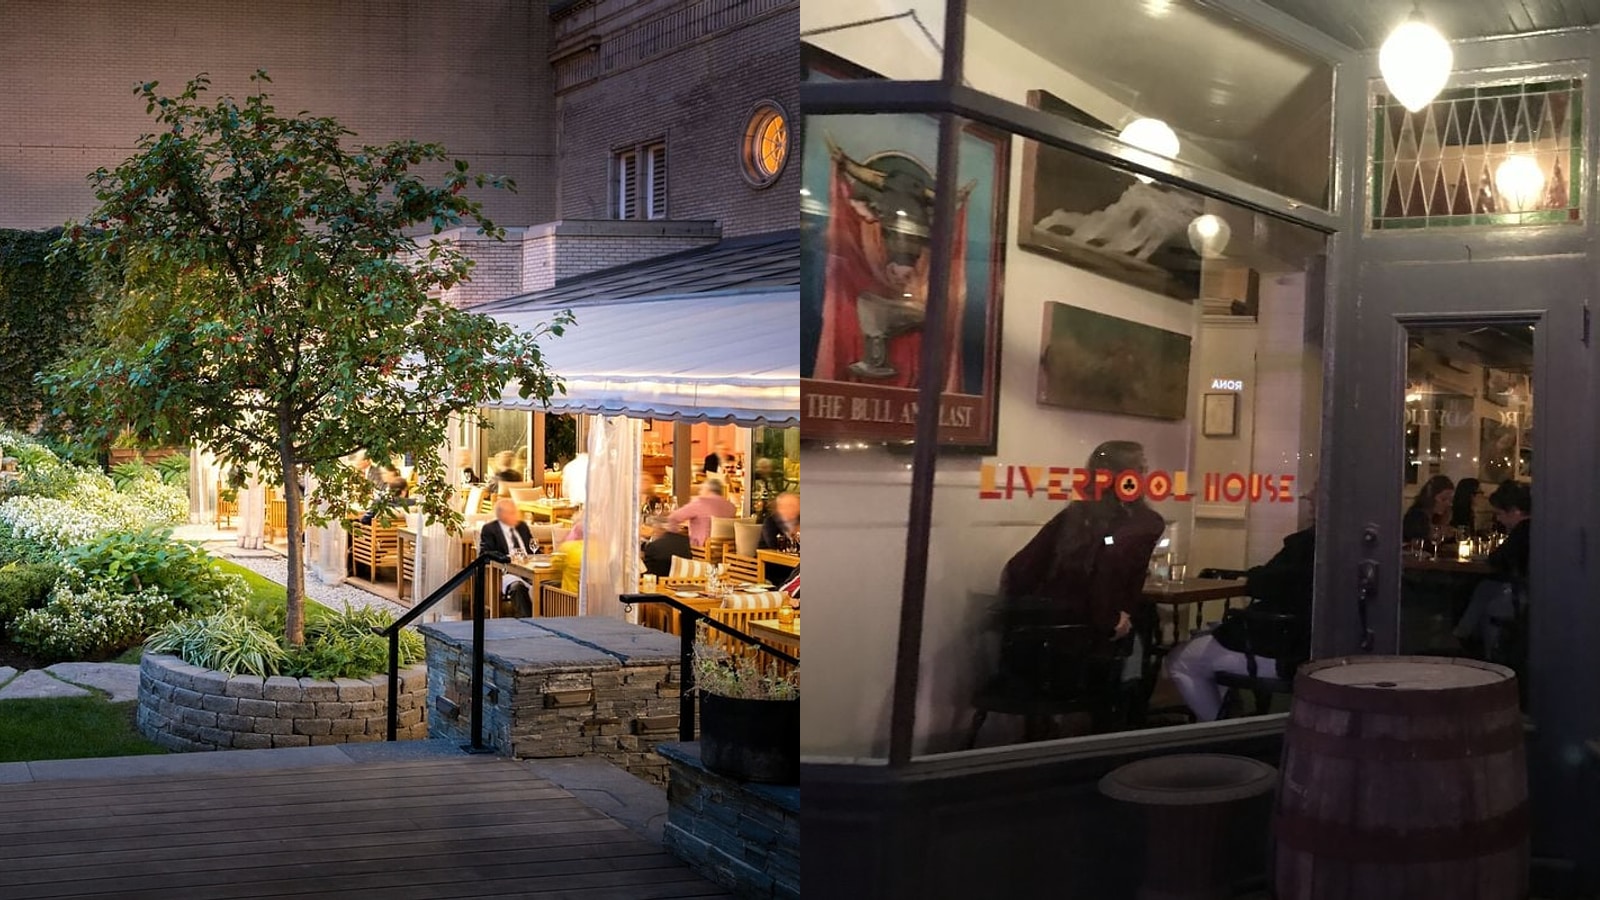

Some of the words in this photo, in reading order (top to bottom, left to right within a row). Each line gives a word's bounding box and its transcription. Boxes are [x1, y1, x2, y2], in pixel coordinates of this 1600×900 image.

[806, 393, 845, 420] THE
[851, 397, 896, 424] BULL
[938, 406, 974, 428] LAST
[979, 464, 1193, 502] LIVERPOOL
[1204, 472, 1296, 503] HOUSE
